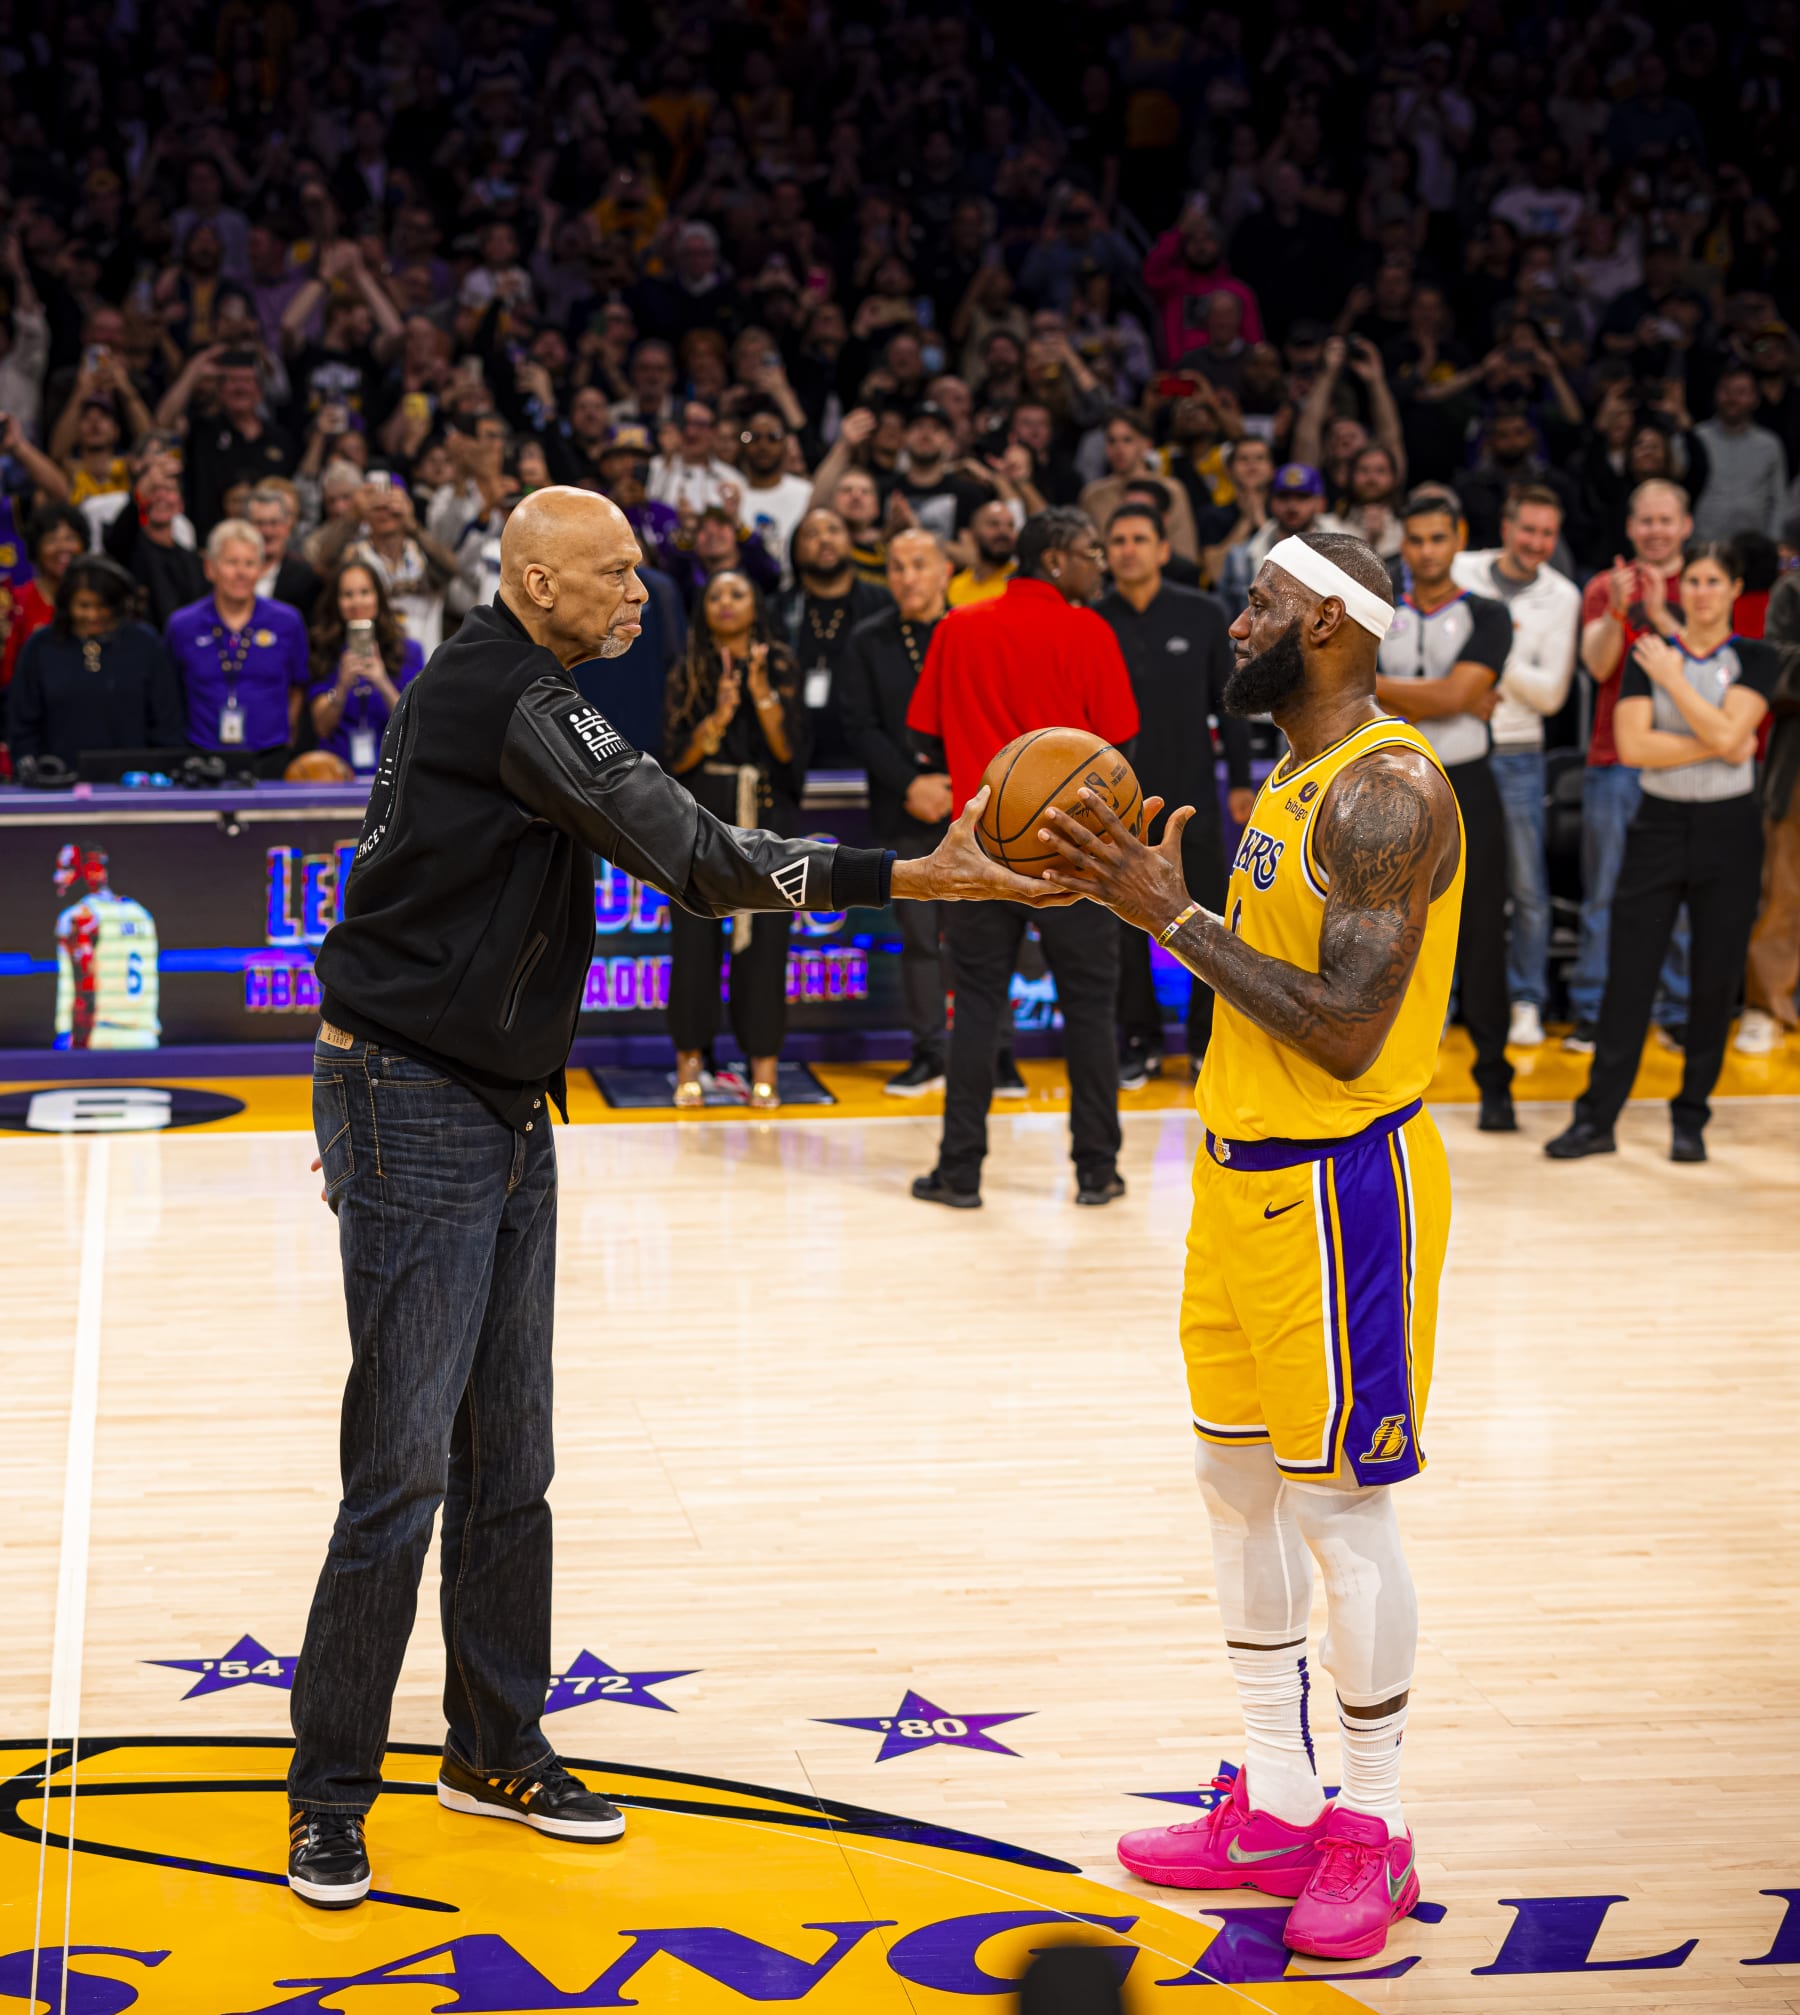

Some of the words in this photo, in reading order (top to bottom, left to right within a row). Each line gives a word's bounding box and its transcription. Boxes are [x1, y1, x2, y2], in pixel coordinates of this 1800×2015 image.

[1284, 797, 1309, 822] bibigo
[202, 1659, 285, 1679] '54
[548, 1675, 634, 1695] '72
[878, 1717, 969, 1739] '80
